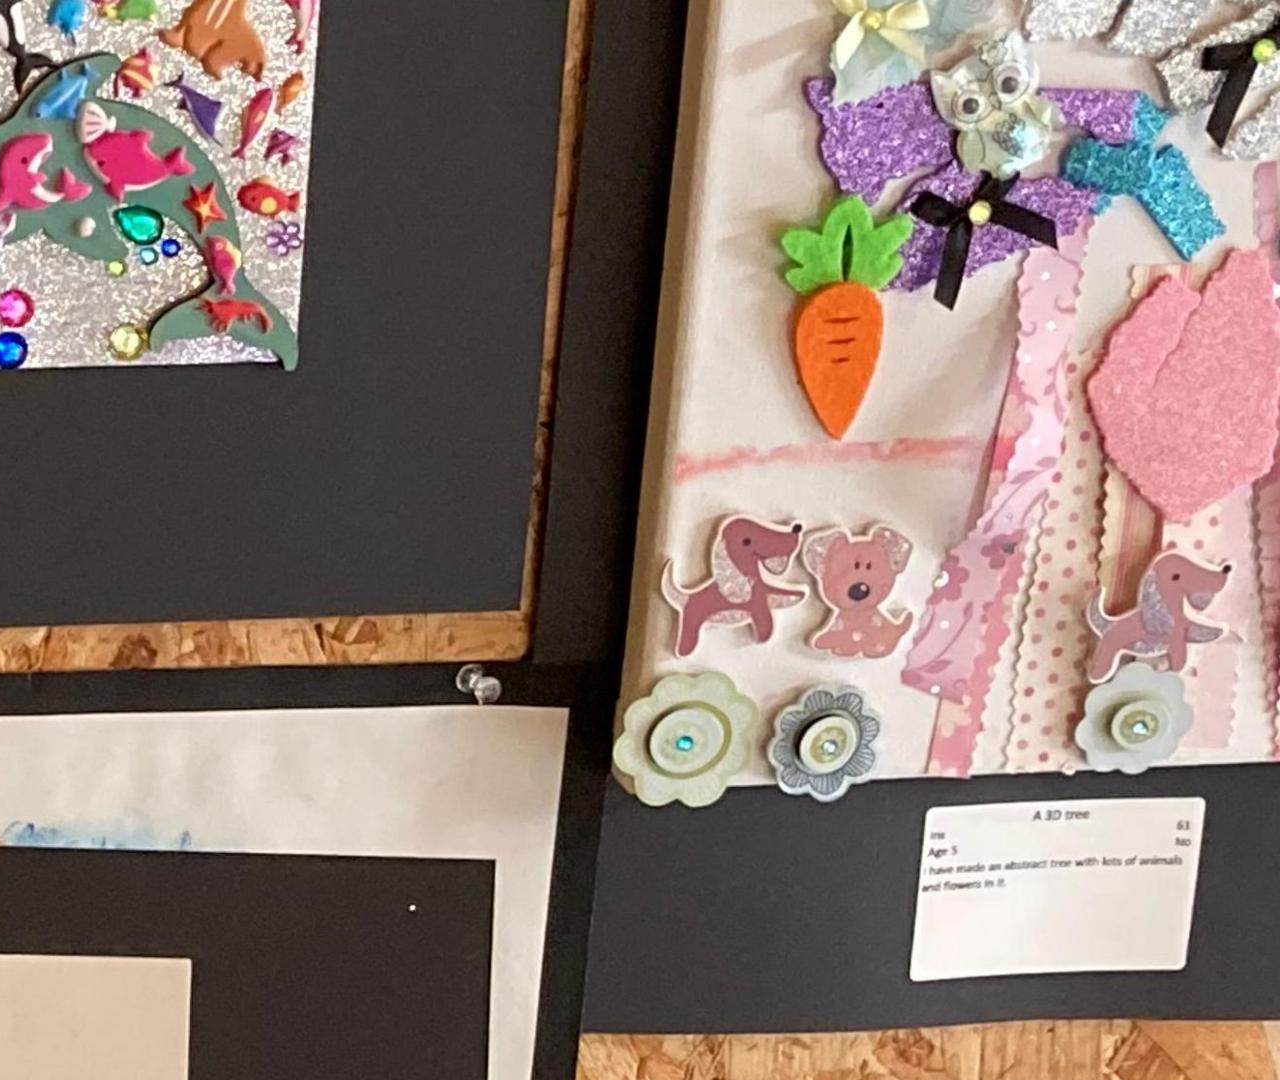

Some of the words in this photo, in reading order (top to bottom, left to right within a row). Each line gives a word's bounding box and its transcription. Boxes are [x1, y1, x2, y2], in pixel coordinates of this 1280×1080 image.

[1032, 810, 1043, 821] A
[1045, 809, 1062, 821] 3D
[1065, 808, 1091, 820] tree
[1175, 837, 1193, 847] No
[928, 847, 949, 859] Age
[951, 845, 959, 856] 5
[929, 864, 954, 875] have
[956, 861, 986, 873] made
[988, 862, 1002, 872] an
[1004, 858, 1048, 871] abstract
[1050, 858, 1072, 869] tree
[1074, 856, 1100, 868] with
[1102, 856, 1123, 867] lots
[1125, 855, 1138, 867] of
[1139, 855, 1184, 867] animals
[922, 881, 942, 893] and
[943, 880, 982, 891] flowers
[984, 879, 995, 889] in
